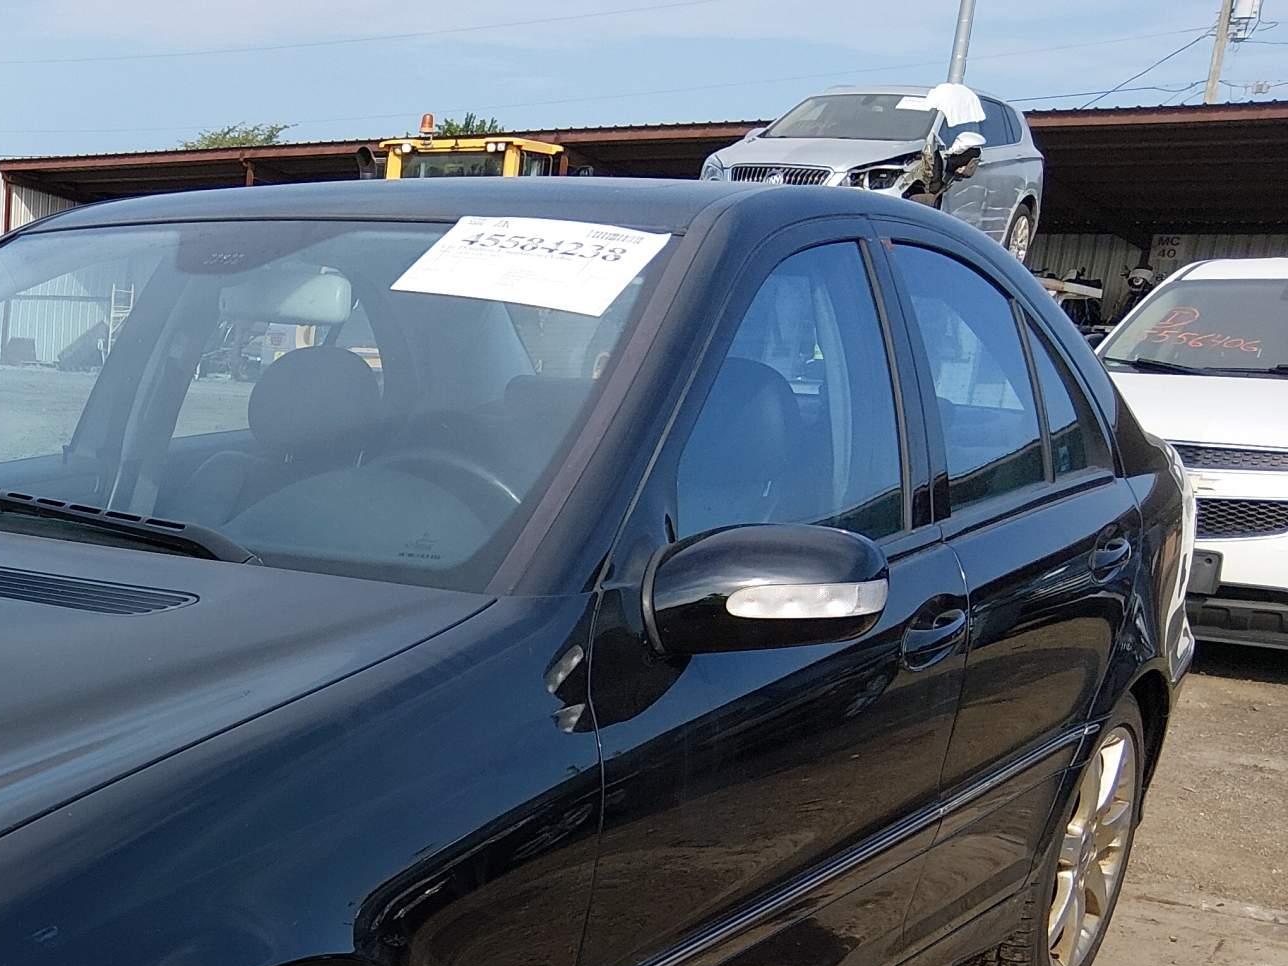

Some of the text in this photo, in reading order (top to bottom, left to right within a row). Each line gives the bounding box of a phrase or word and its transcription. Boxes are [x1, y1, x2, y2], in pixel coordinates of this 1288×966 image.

[1158, 236, 1180, 246] MC
[461, 232, 627, 263] 45584238
[1157, 249, 1176, 258] 40
